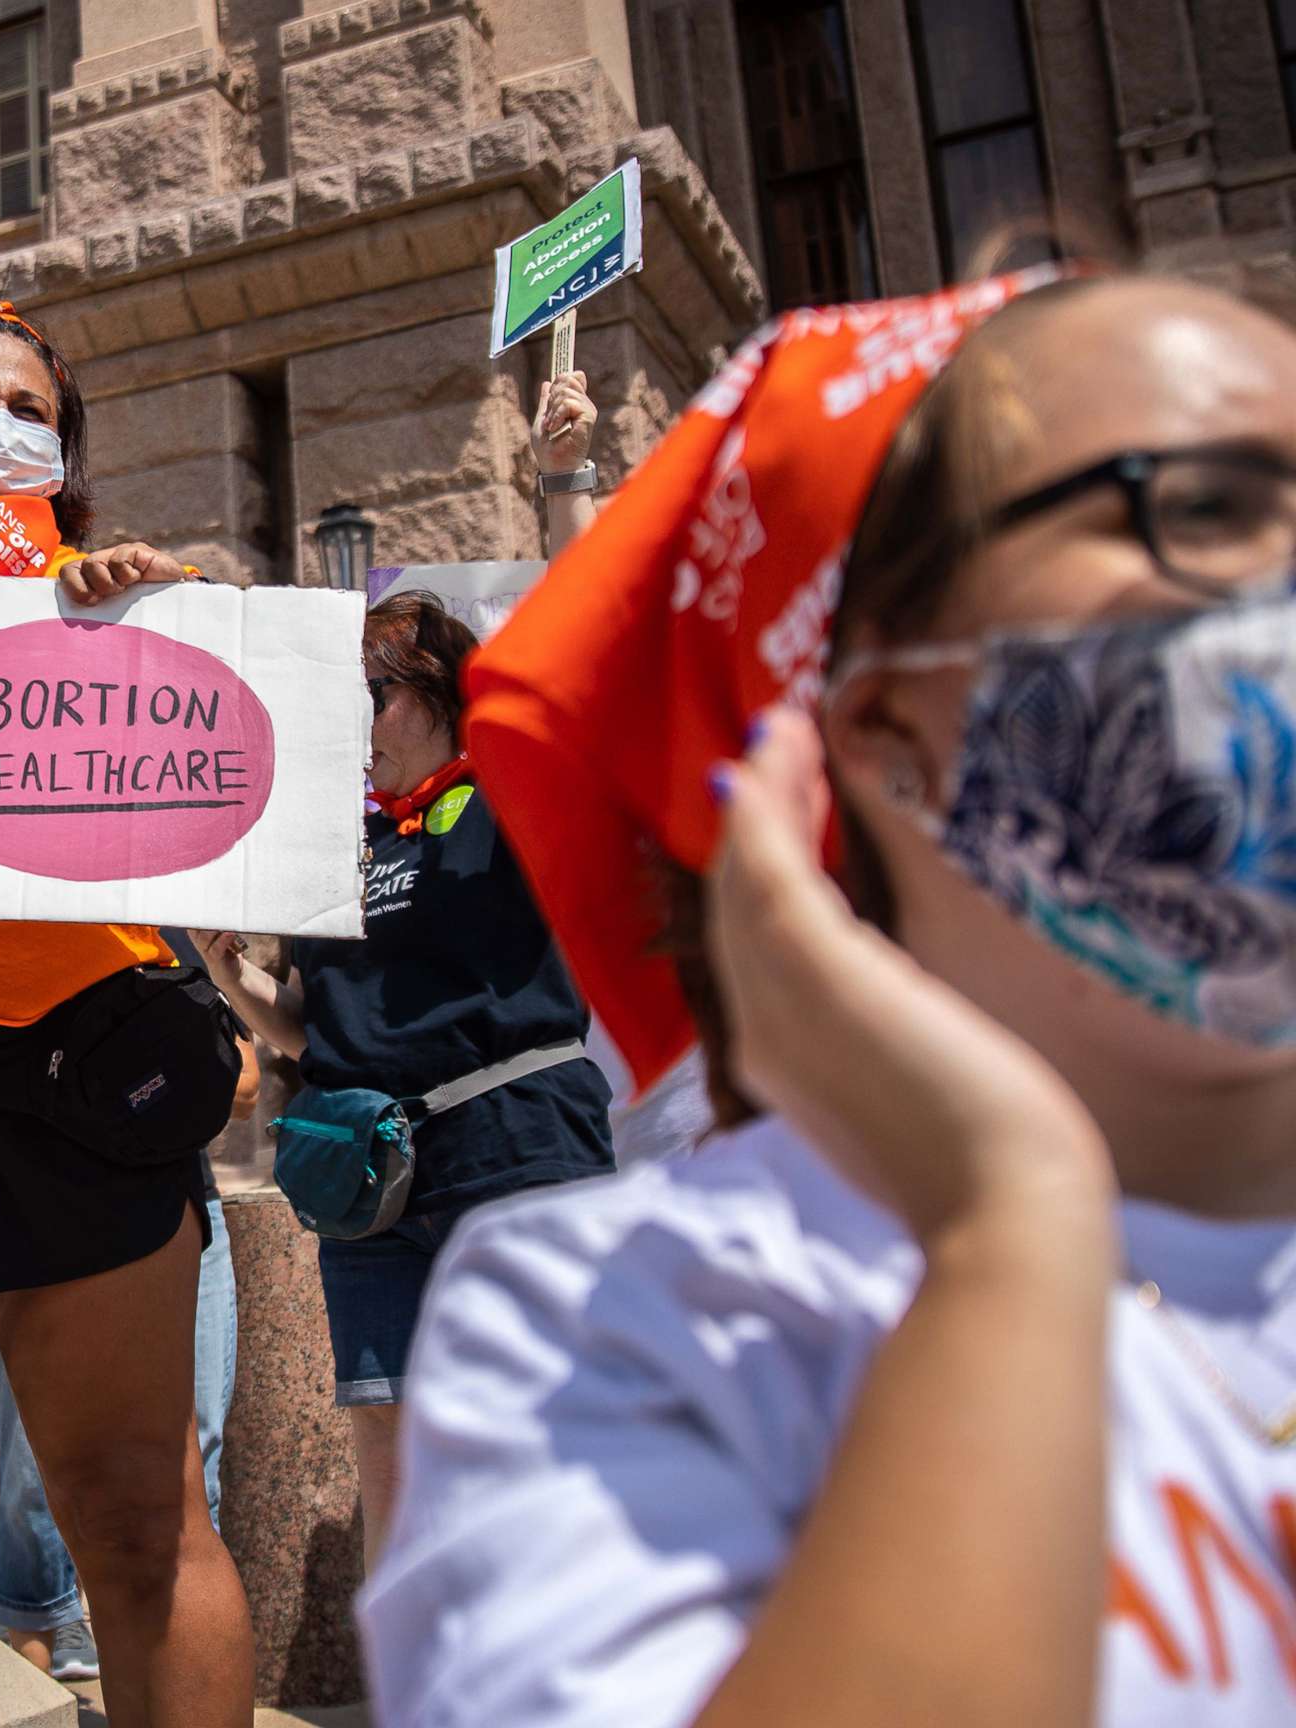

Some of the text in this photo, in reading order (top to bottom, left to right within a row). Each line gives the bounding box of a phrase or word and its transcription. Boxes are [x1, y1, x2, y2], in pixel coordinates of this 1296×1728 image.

[522, 212, 611, 276] Abortion
[532, 201, 604, 254] Protect
[529, 234, 604, 287] Access
[8, 532, 47, 569] OUR
[382, 900, 412, 914] Women
